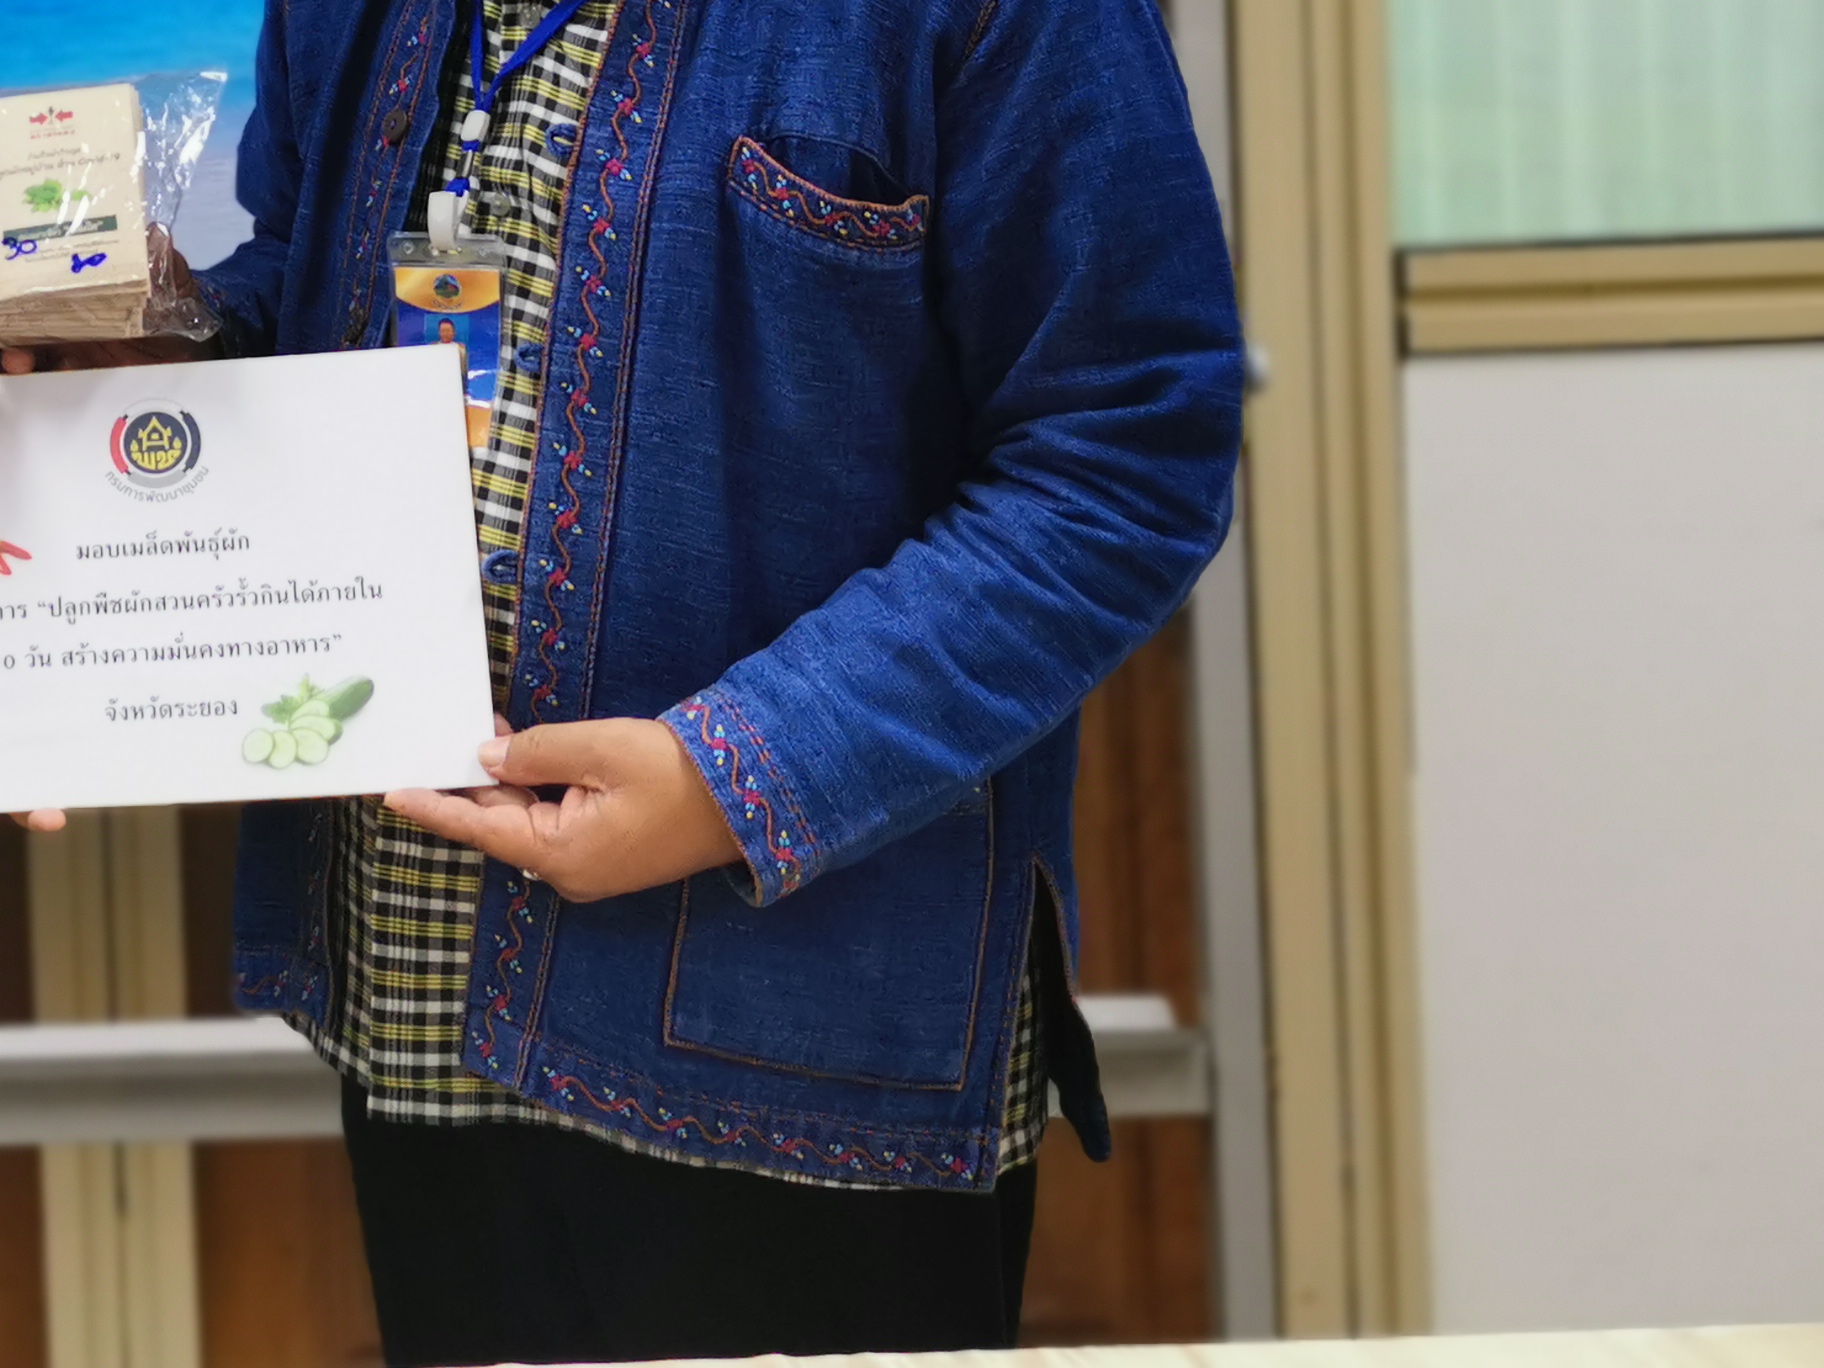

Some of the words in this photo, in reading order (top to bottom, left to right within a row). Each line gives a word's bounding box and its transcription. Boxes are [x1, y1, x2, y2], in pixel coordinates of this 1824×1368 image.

[76, 527, 250, 561] มอบเมล็ดพันธุ์ผัก
[25, 644, 52, 668] วัน
[105, 695, 239, 722] จังหวัดระยอง
